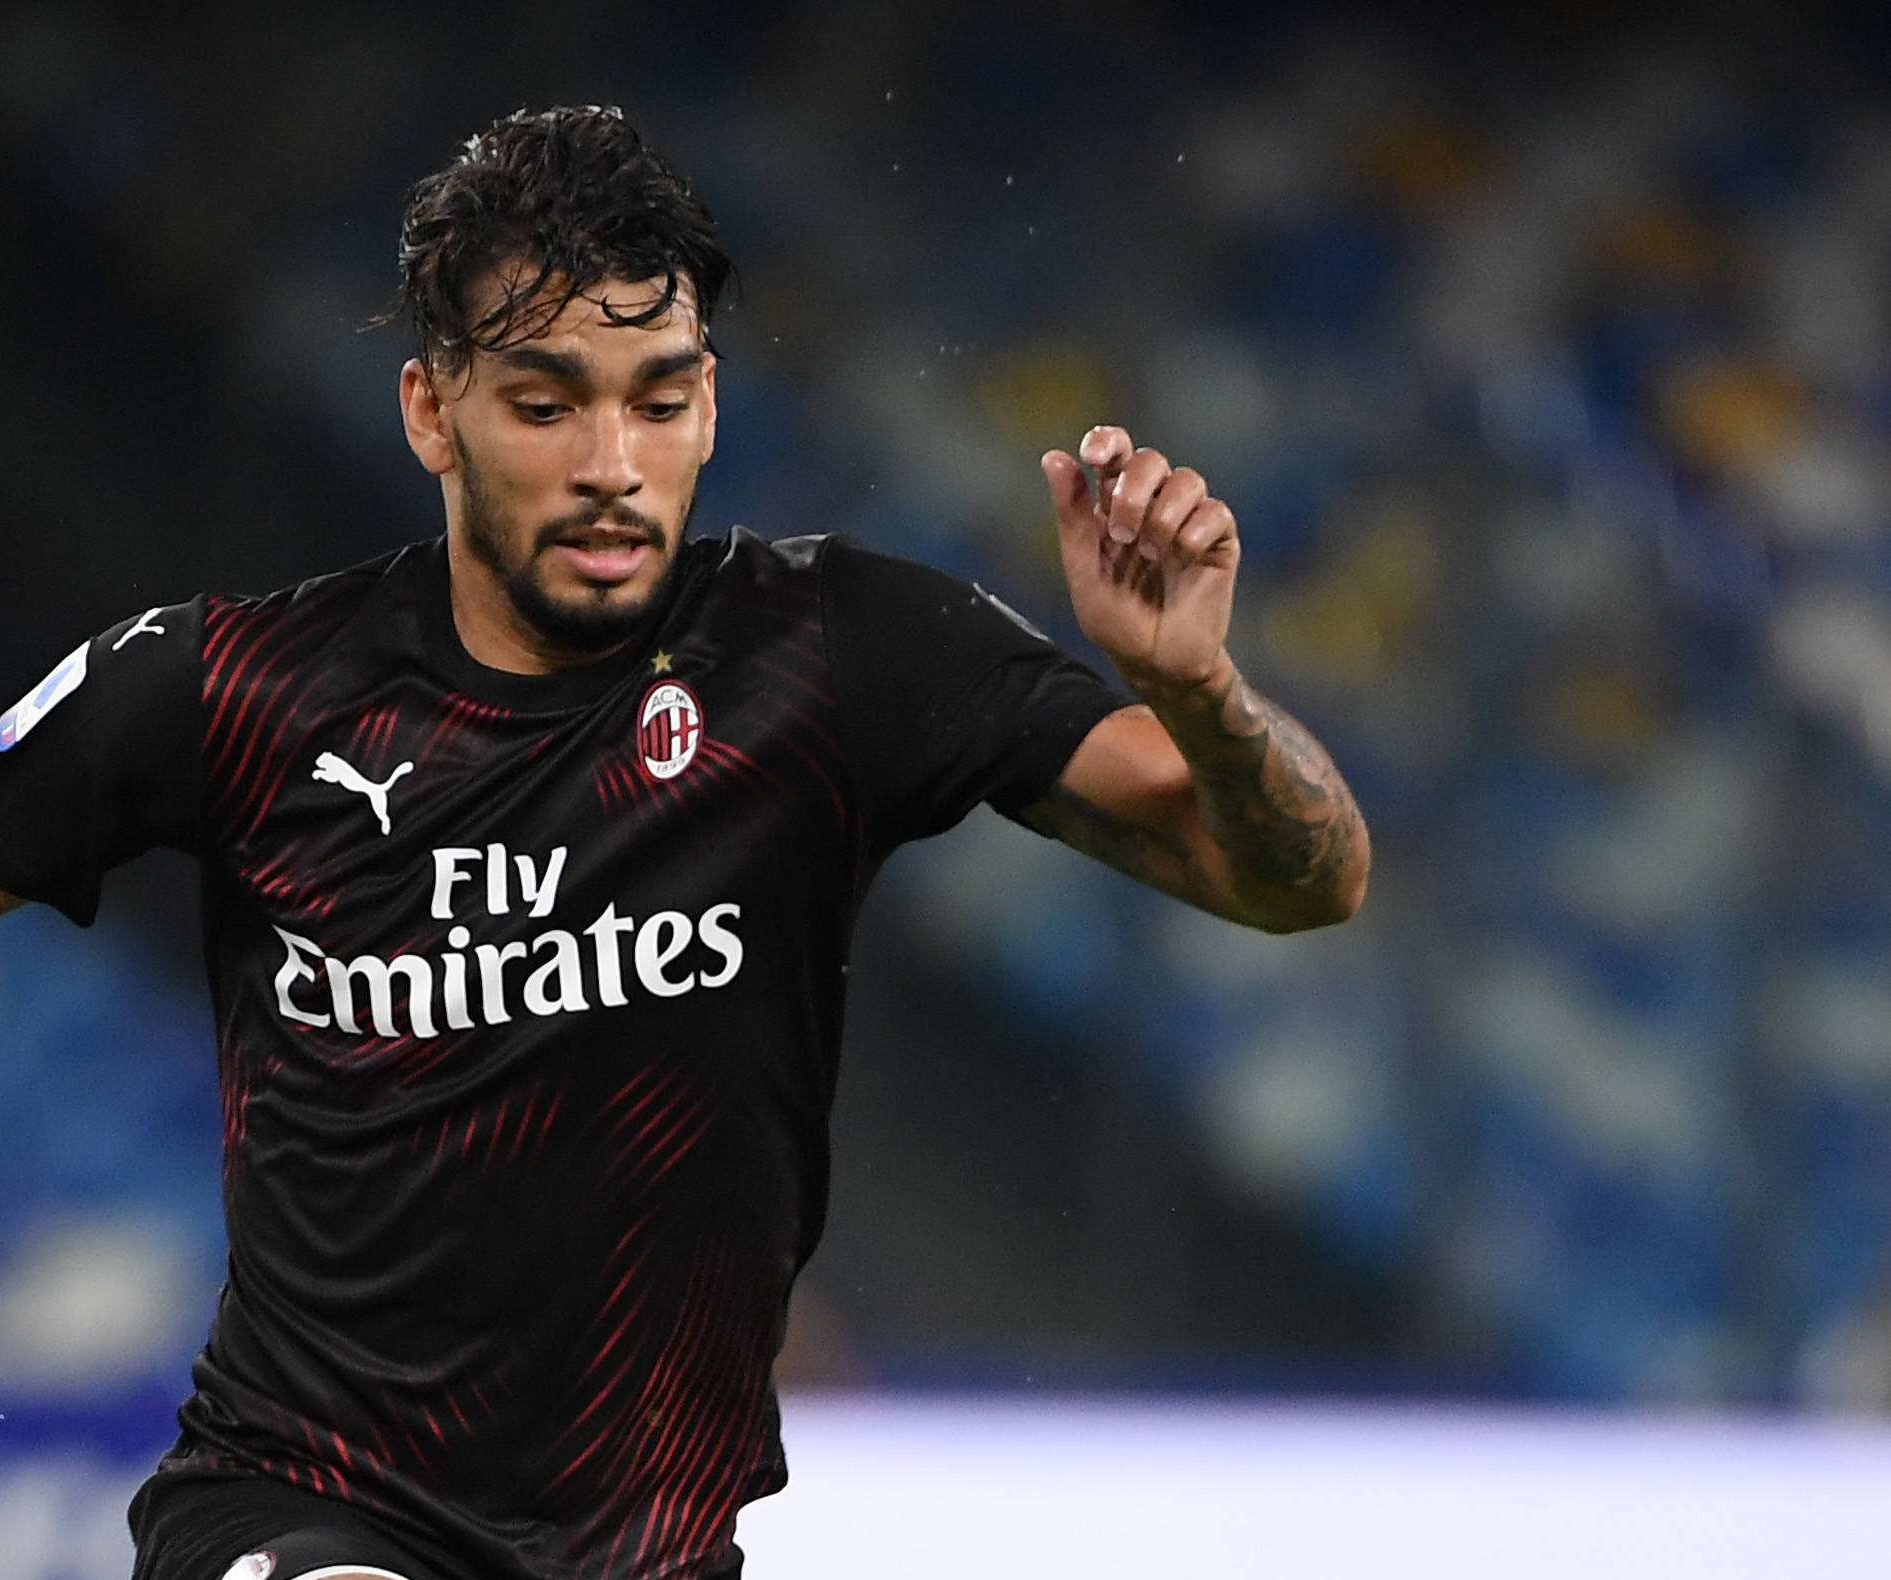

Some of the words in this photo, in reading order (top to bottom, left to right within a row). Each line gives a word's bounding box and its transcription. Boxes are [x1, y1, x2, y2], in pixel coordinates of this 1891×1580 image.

[650, 689, 688, 713] ACM
[431, 843, 567, 919] Fly
[272, 901, 744, 1039] Emirates
